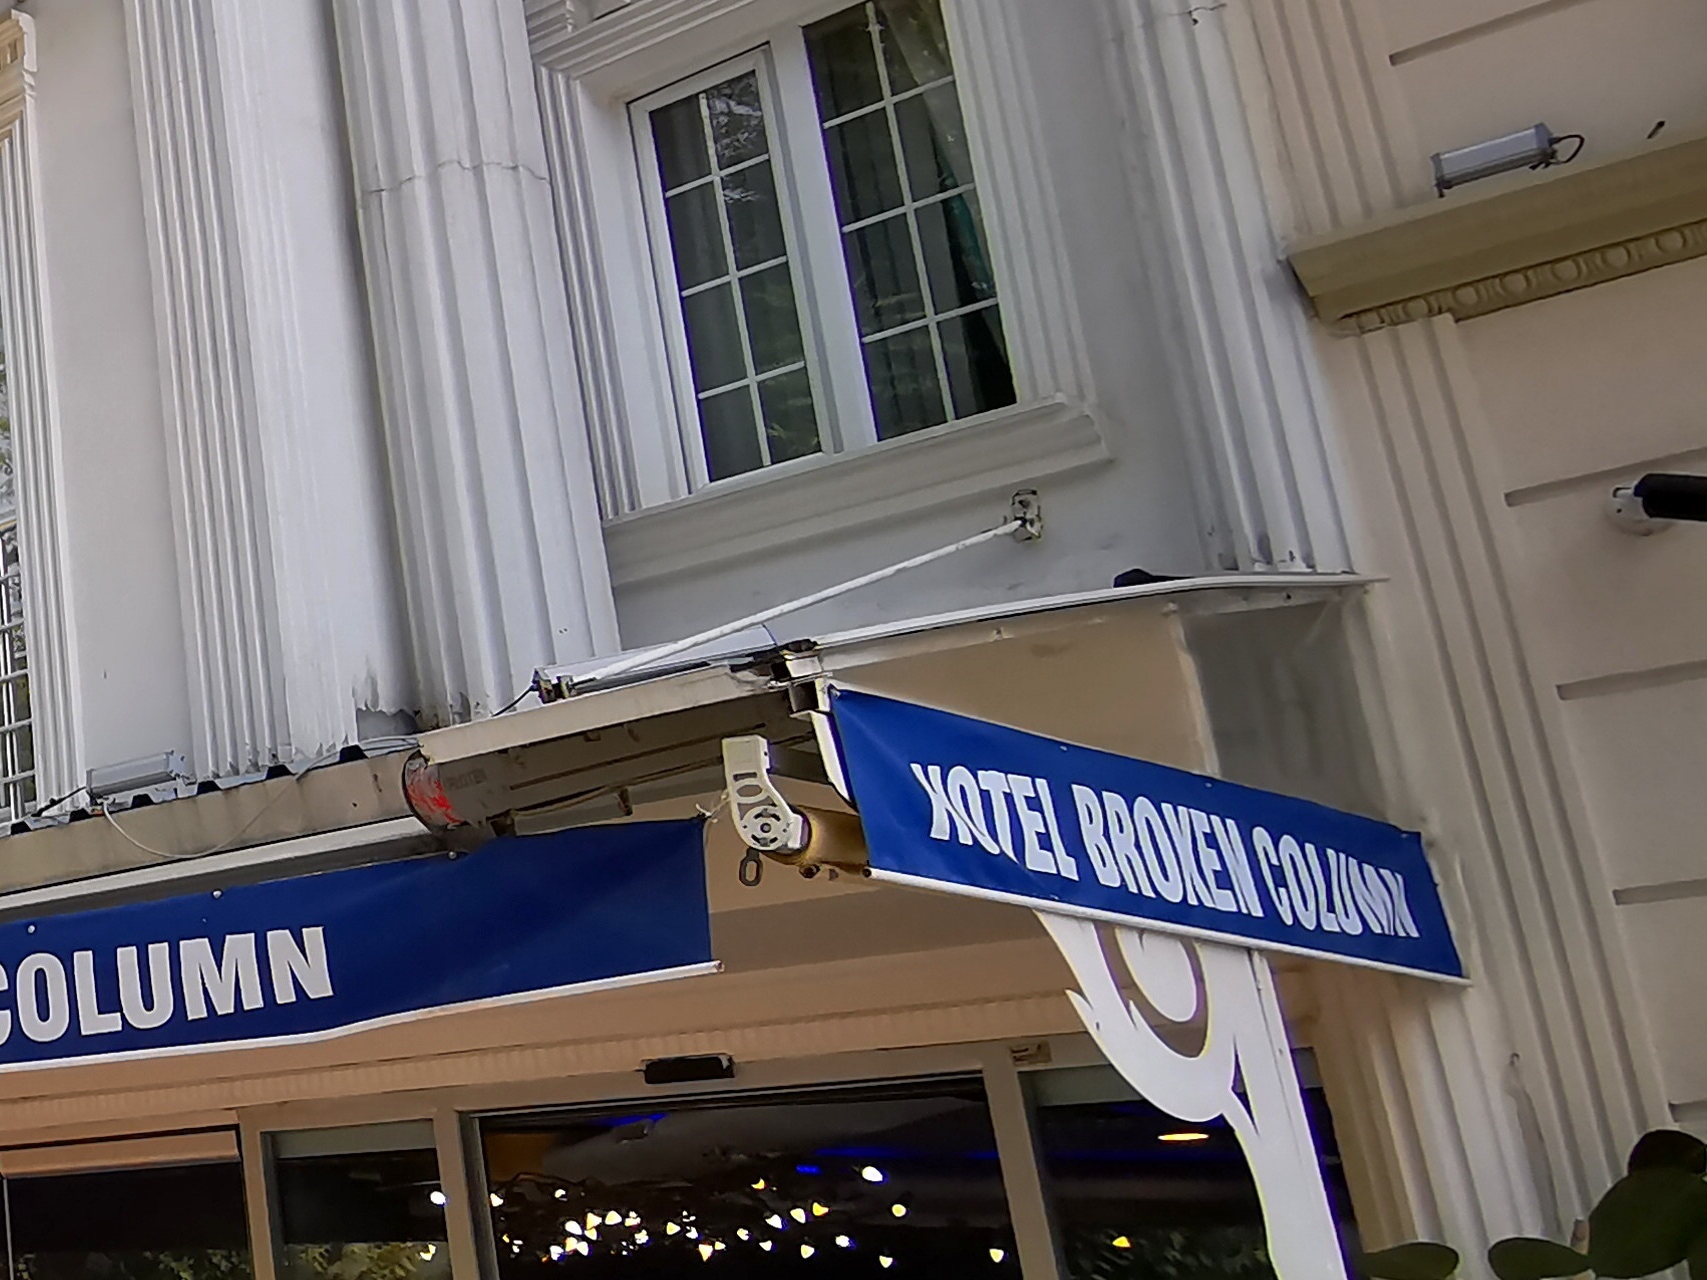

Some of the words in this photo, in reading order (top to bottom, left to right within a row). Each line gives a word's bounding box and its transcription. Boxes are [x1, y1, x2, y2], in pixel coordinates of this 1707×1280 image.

[910, 762, 1080, 881] HOTEL
[1071, 783, 1264, 918] BROKEN
[1251, 825, 1420, 939] COLUMN
